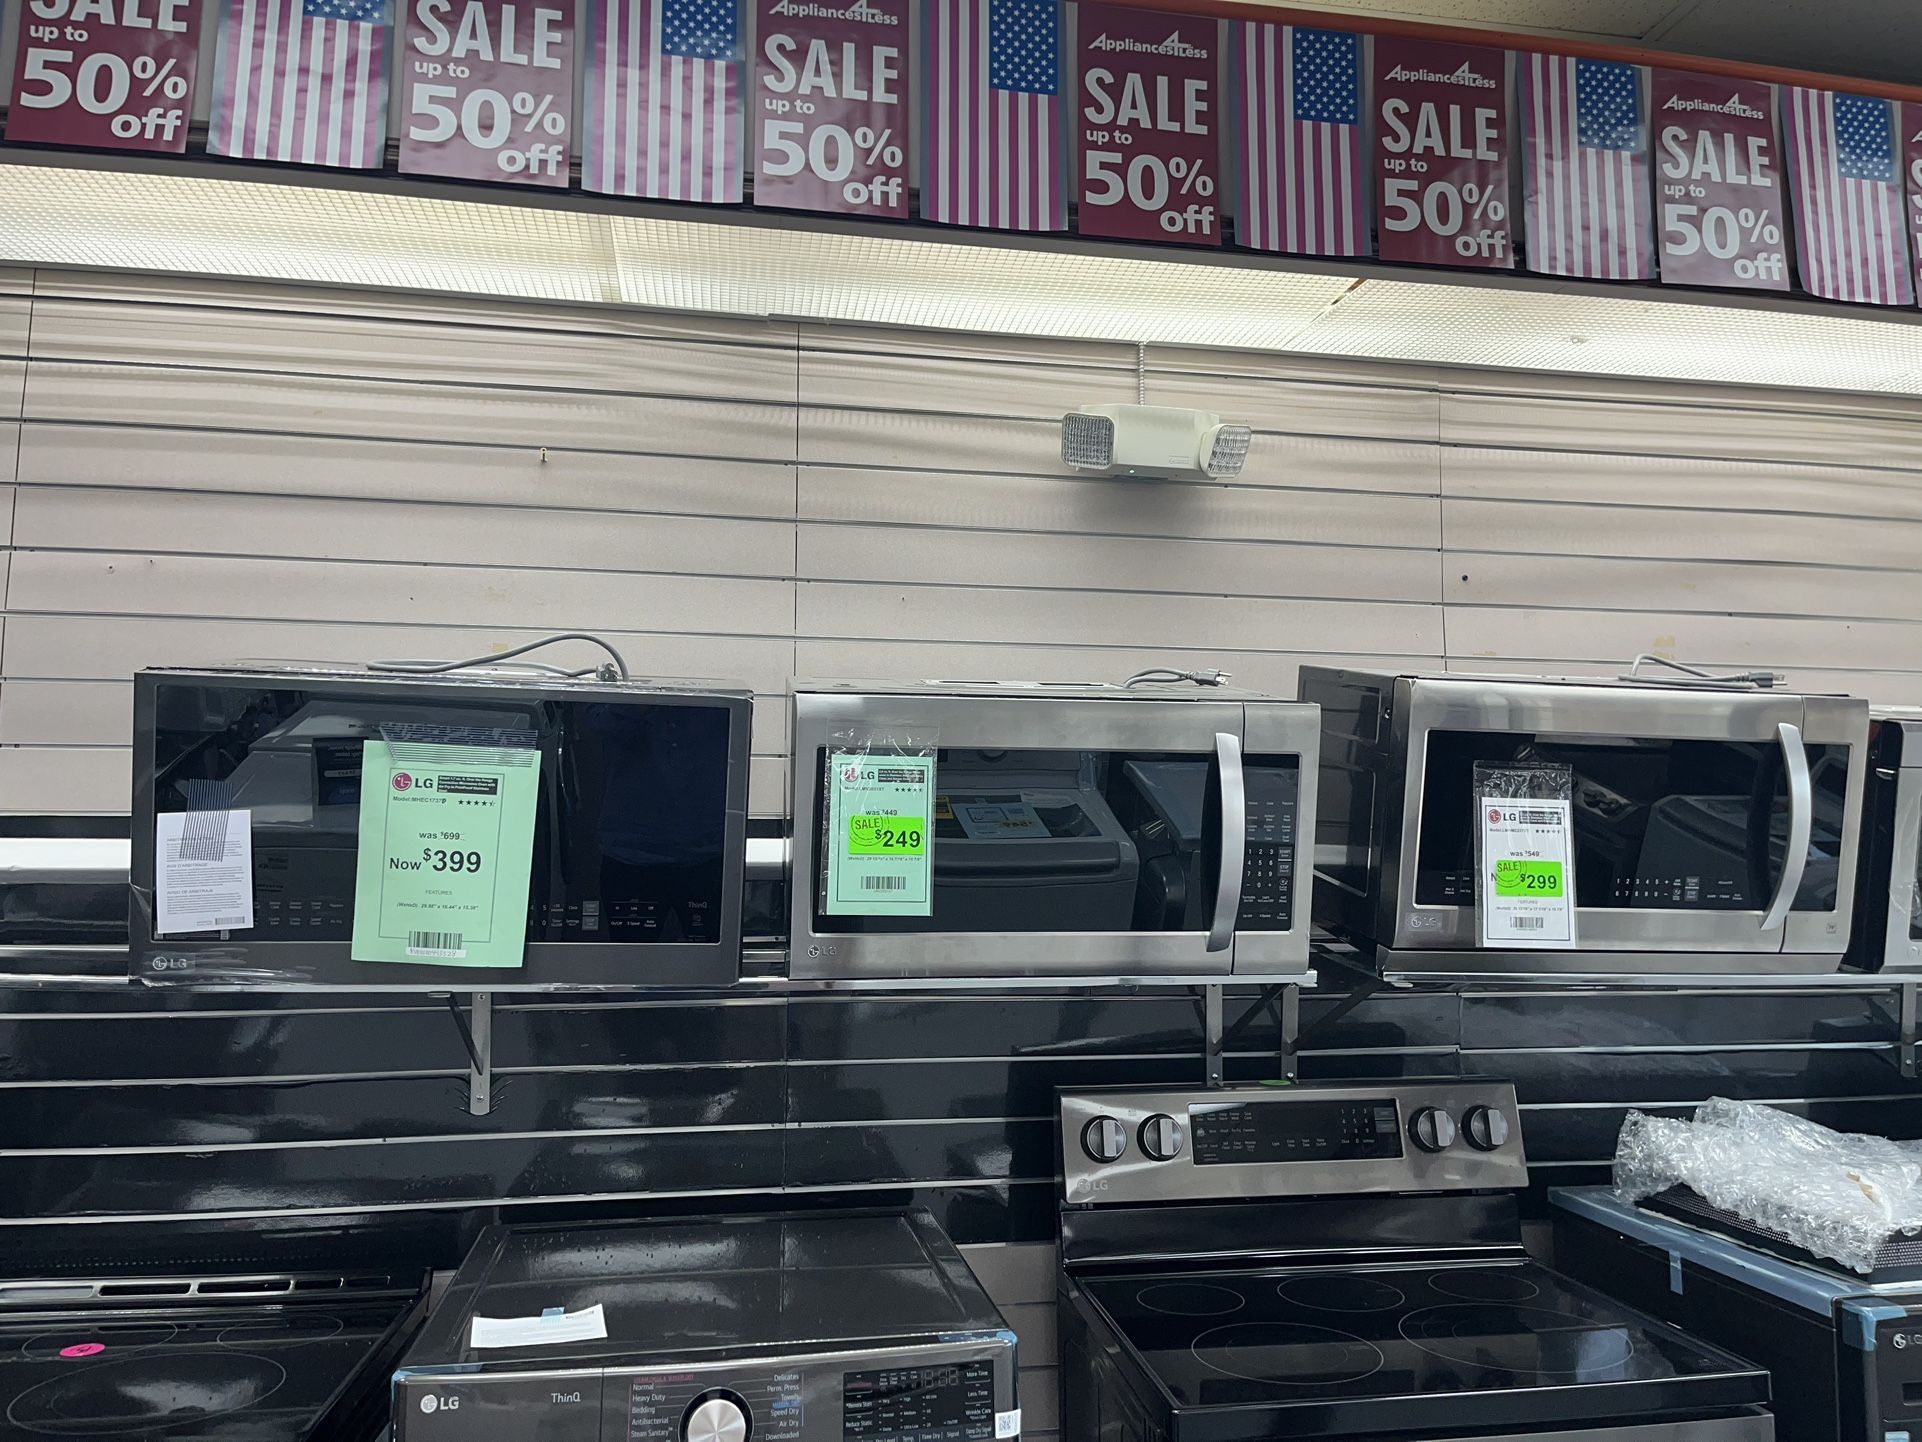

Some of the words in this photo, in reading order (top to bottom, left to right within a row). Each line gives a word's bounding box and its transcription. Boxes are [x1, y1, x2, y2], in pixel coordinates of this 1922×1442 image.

[30, 25, 59, 43] up
[64, 26, 89, 42] to
[413, 0, 563, 69] SALE
[415, 61, 443, 78] up
[447, 62, 470, 78] to
[763, 33, 899, 104] SALE
[20, 47, 188, 115] 50%
[764, 98, 790, 115] up
[794, 99, 815, 115] to
[1084, 67, 1209, 136] SALE
[111, 107, 183, 141] off
[409, 82, 566, 149] 50%
[1085, 129, 1107, 146] up
[1112, 131, 1133, 145] to
[1382, 98, 1499, 161] SALE
[762, 118, 904, 182] 50%
[1661, 125, 1772, 187] SALE
[497, 143, 564, 176] off
[1384, 157, 1406, 174] up
[1410, 158, 1428, 173] to
[1084, 149, 1214, 211] 50%
[842, 175, 903, 208] off
[1664, 183, 1685, 200] up
[1688, 184, 1706, 199] to
[1384, 177, 1505, 237] 50%
[1160, 204, 1214, 235] off
[1664, 203, 1779, 259] 50%
[1455, 229, 1507, 259] off
[1733, 251, 1782, 281] off
[415, 777, 434, 789] LG
[861, 771, 875, 780] LG
[855, 818, 880, 830] SALE
[1503, 812, 1517, 821] LG
[419, 832, 438, 840] was
[875, 828, 921, 848] $249
[389, 857, 422, 871] Now
[423, 847, 482, 873] $399
[1497, 861, 1519, 873] SALE
[1520, 873, 1557, 889] $299
[170, 958, 187, 969] LG
[1092, 1179, 1108, 1191] LG
[774, 1373, 799, 1382] Delicates
[632, 1383, 655, 1391] Normal
[784, 1383, 799, 1391] Press
[440, 1395, 459, 1410] LG
[551, 1391, 582, 1403] ThinQ
[632, 1394, 650, 1402] Heavy
[651, 1393, 666, 1402] Duty
[631, 1406, 656, 1415] Bedding
[770, 1408, 788, 1418] Speed
[788, 1408, 799, 1416] Dry
[631, 1416, 669, 1425] Antibacterial
[779, 1420, 787, 1428] Air
[788, 1419, 799, 1428] Dry
[630, 1430, 647, 1438] Steam
[765, 1431, 800, 1441] Downloaded
